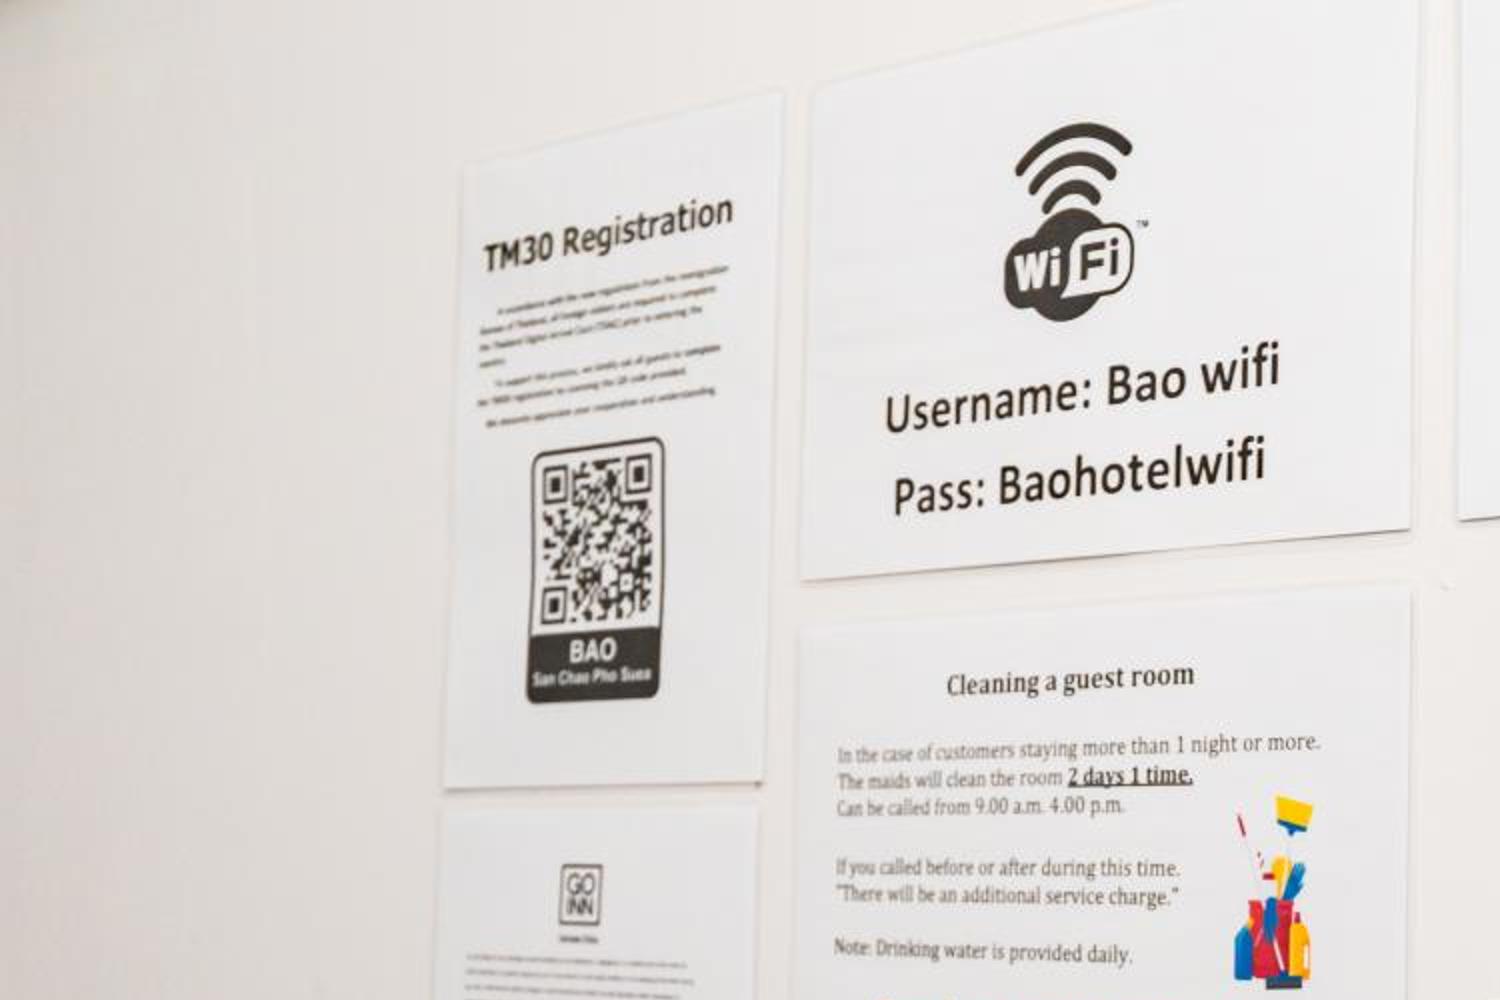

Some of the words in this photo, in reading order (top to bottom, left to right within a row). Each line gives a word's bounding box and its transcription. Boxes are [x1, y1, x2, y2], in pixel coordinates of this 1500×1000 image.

[482, 231, 554, 273] TM30
[562, 198, 733, 257] Registration
[886, 379, 1091, 434] Username:
[1107, 364, 1187, 406] Bao
[1200, 340, 1279, 394] wifi
[894, 477, 985, 517] Pass:
[999, 435, 1265, 505] Baohotelwifi
[571, 638, 616, 662] BAO
[947, 672, 1039, 699] Cleaning
[1045, 674, 1057, 691] a
[1063, 667, 1125, 697] guest
[1131, 667, 1194, 687] room
[838, 748, 852, 763] In
[856, 746, 879, 763] the
[882, 749, 913, 762] case
[917, 743, 933, 761] of
[935, 745, 1015, 761] customers
[1020, 741, 1078, 762] staying
[1083, 741, 1126, 756] more
[1131, 736, 1170, 755] than
[1191, 733, 1237, 759] night
[1243, 737, 1263, 752] or
[1268, 736, 1321, 751] more.
[838, 773, 864, 790] The
[868, 772, 911, 789] maids
[914, 771, 942, 789] will
[946, 771, 986, 788] clean
[990, 769, 1015, 787] the
[1020, 772, 1062, 786] room
[1068, 767, 1078, 787] 2
[1083, 766, 1125, 788] days
[1146, 766, 1194, 787] time.
[837, 800, 863, 817] Can
[867, 800, 884, 816] be
[887, 798, 930, 816] called
[934, 798, 970, 816] from
[975, 797, 1009, 815] 9.00
[1049, 796, 1085, 814] 4.00
[836, 858, 848, 875] If
[849, 861, 876, 879] you
[879, 858, 923, 876] called
[926, 858, 975, 876] before
[978, 862, 995, 876] or
[999, 857, 1037, 877] after
[1041, 856, 1096, 882] during
[1100, 857, 1132, 877] this
[1137, 859, 1181, 877] time.
[566, 873, 595, 895] GO
[887, 884, 914, 902] will
[917, 885, 936, 903] be
[938, 890, 957, 903] an
[961, 885, 1041, 904] additional
[1045, 887, 1104, 905] service
[566, 897, 594, 916] INN
[876, 938, 940, 963] Drinking
[944, 944, 988, 960] water
[992, 944, 1005, 960] is
[1009, 944, 1083, 965] provided
[1087, 944, 1133, 970] daily.
